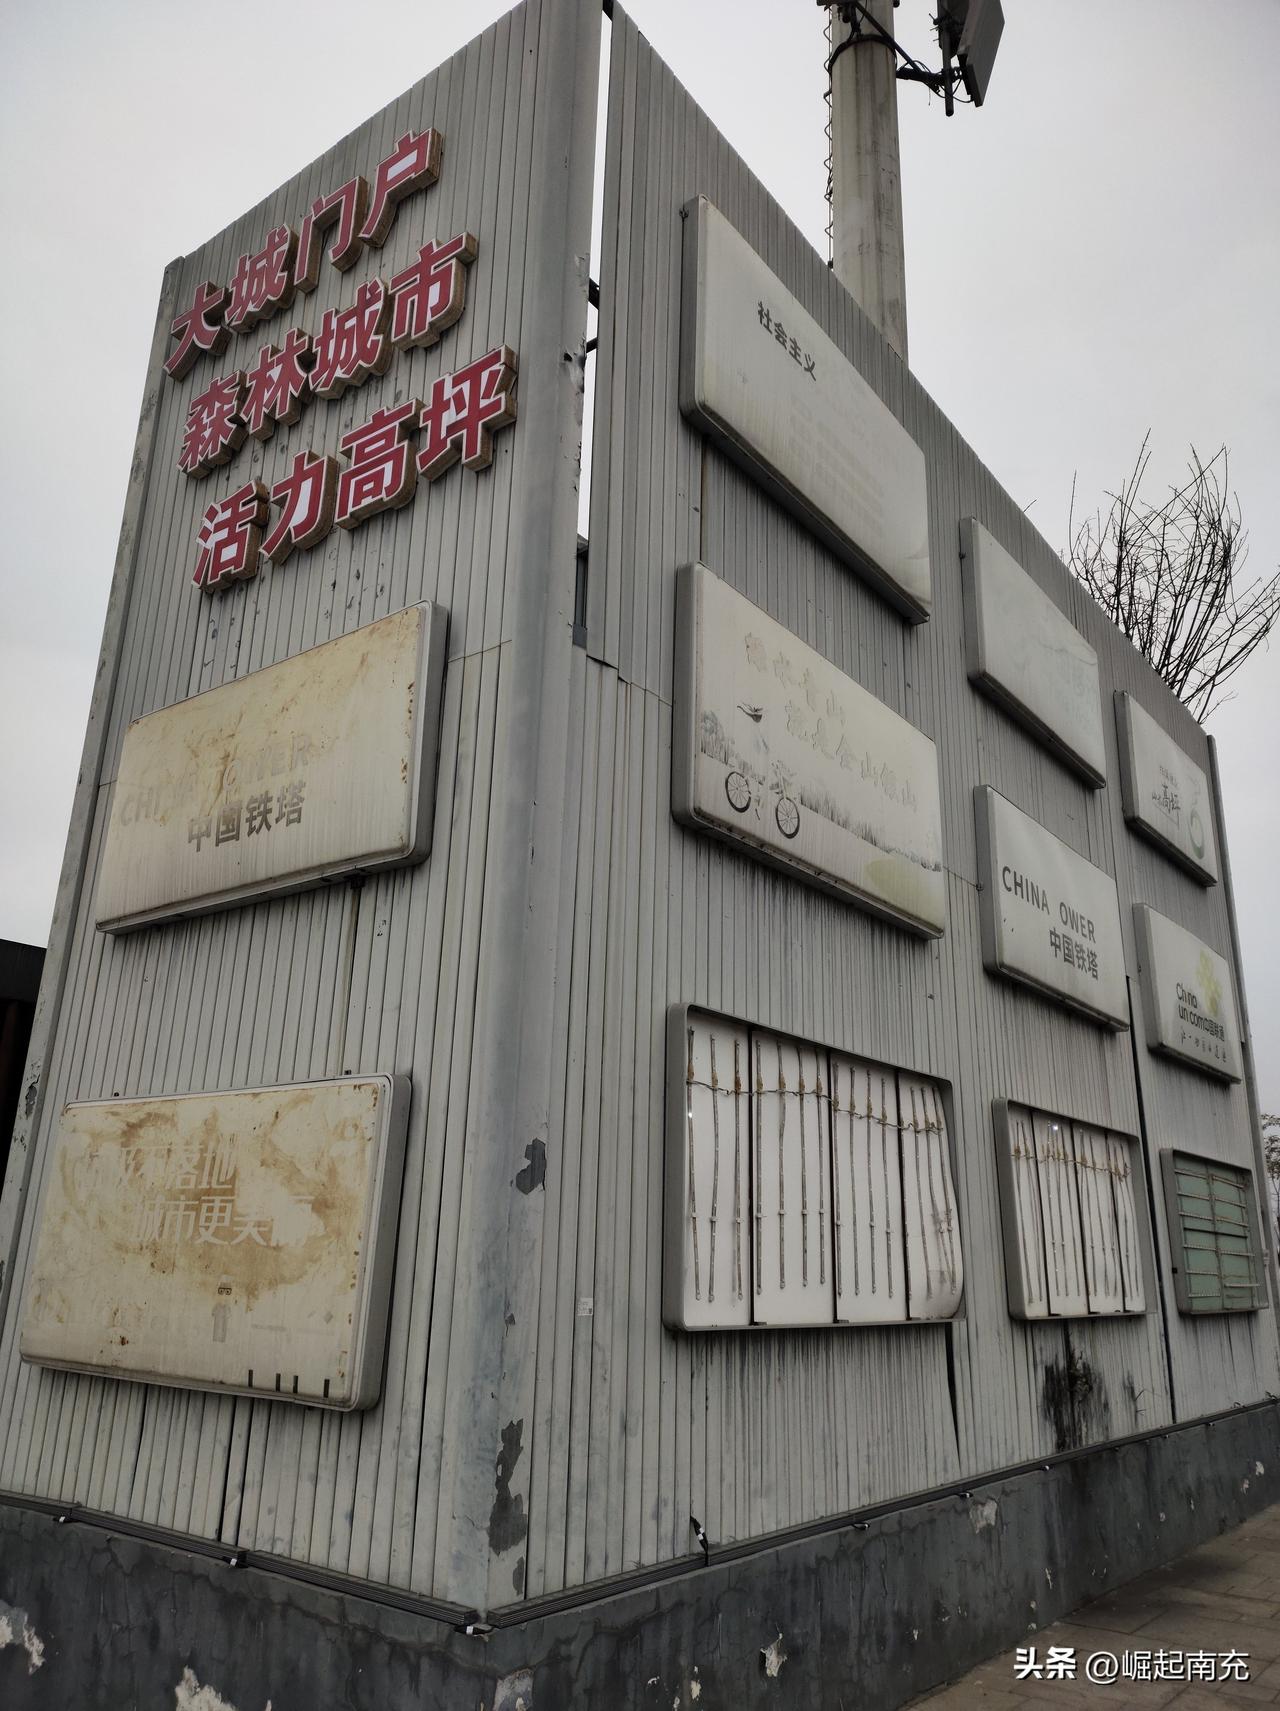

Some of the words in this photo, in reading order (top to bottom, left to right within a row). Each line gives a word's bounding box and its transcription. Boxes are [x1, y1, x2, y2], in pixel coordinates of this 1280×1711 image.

[162, 126, 440, 378] 大城门户
[176, 231, 474, 477] 森林城市
[757, 300, 817, 382] 社会主义
[192, 344, 514, 591] 活力高坪
[187, 780, 306, 853] 中国铁塔
[1002, 866, 1050, 915] CHINA
[1049, 927, 1099, 981] 中国铁塔
